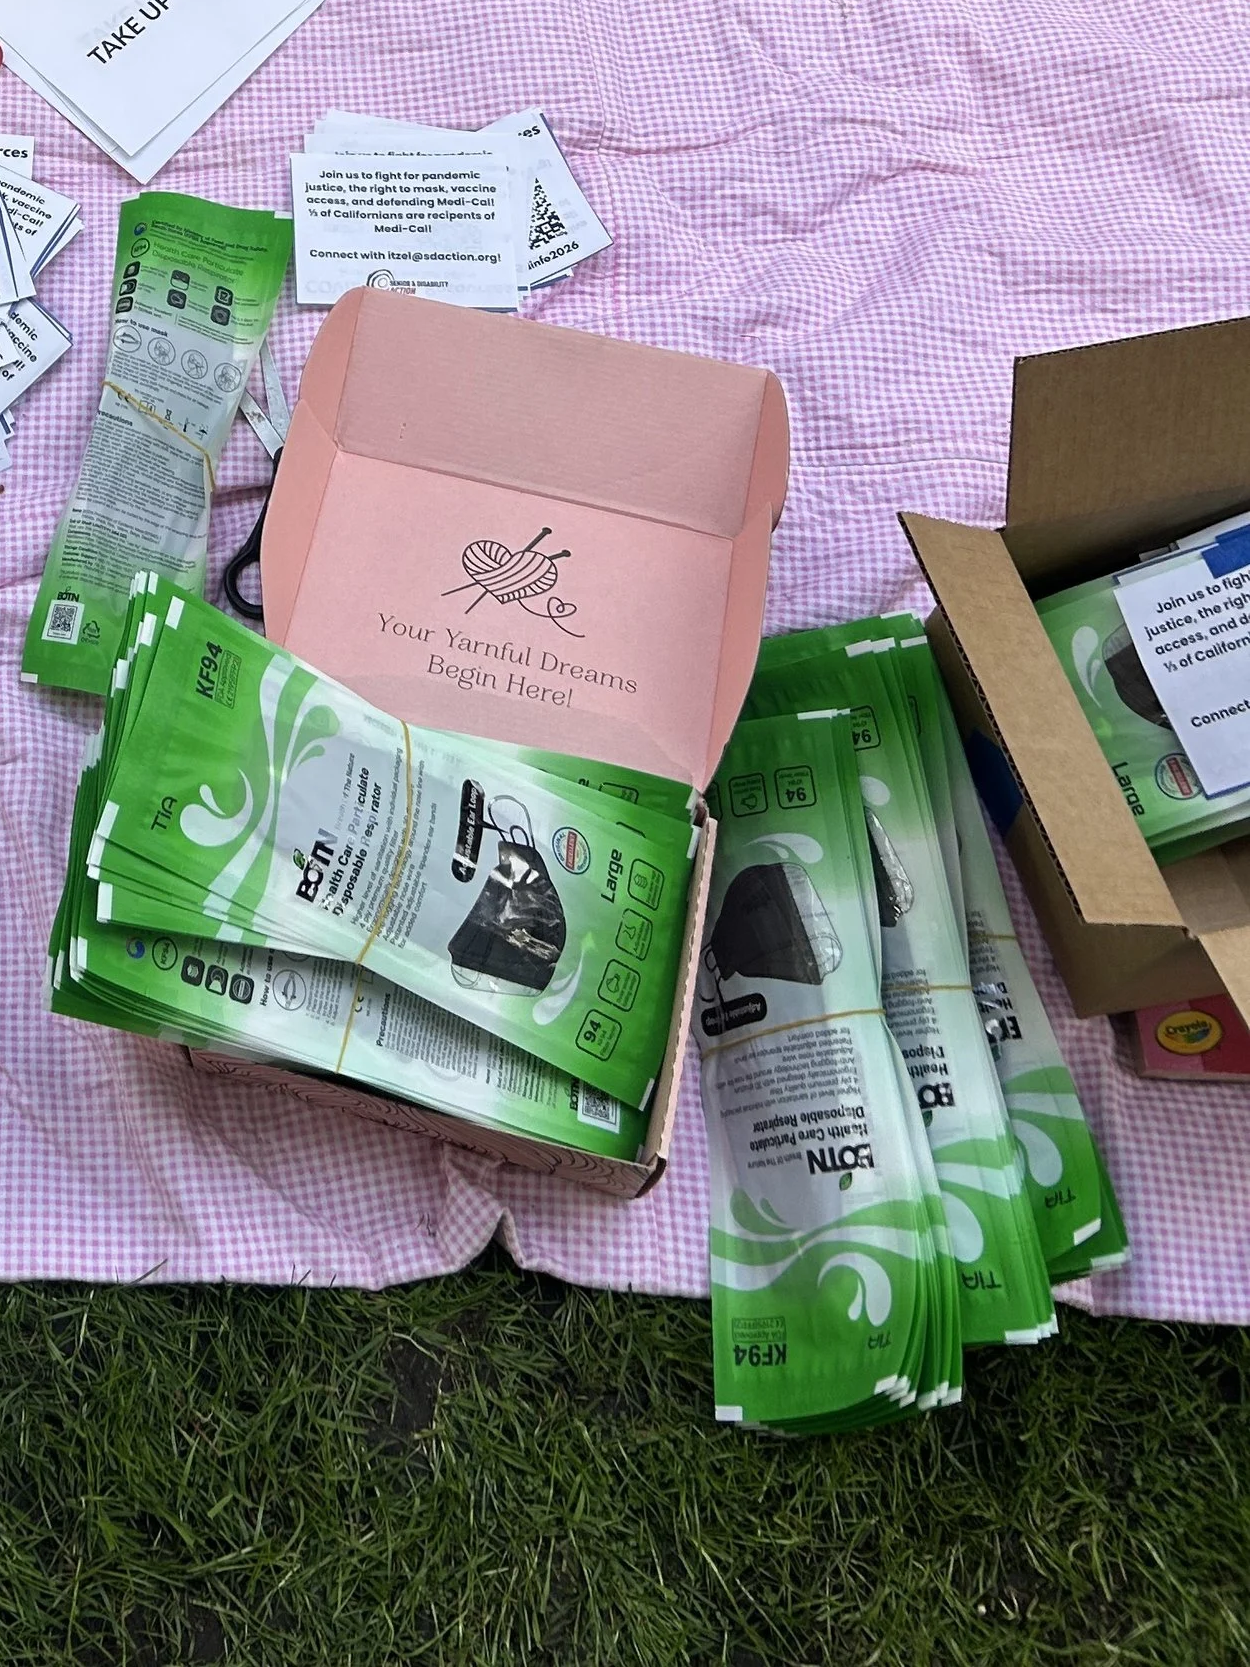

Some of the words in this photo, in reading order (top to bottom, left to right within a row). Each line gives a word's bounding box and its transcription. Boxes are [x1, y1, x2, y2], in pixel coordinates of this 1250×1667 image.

[86, 15, 146, 66] TAKE
[319, 169, 344, 180] Join
[346, 172, 360, 180] us
[361, 171, 374, 180] to
[375, 170, 402, 182] fight
[404, 171, 420, 180] for
[422, 170, 481, 183] pandemic
[305, 183, 346, 194] justice,
[348, 184, 368, 193] the
[370, 184, 397, 195] right
[399, 184, 411, 193] to
[413, 183, 449, 194] mask,
[451, 184, 497, 193] vaccine
[11, 197, 53, 220] vaccine
[306, 197, 349, 207] access,
[351, 197, 374, 206] and
[376, 196, 435, 208] defending
[320, 209, 332, 217] of
[334, 209, 403, 220] Californians
[427, 210, 482, 221] recipents
[484, 210, 496, 220] of
[309, 249, 358, 260] Connect
[360, 250, 386, 260] with
[387, 250, 501, 264] itzel@sdaction.org!
[1155, 596, 1186, 614] Join
[1186, 590, 1205, 602] us
[1206, 584, 1221, 595] to
[1144, 614, 1198, 641] justice,
[1198, 604, 1222, 620] the
[1155, 632, 1209, 656] access,
[1209, 618, 1237, 635] and
[378, 612, 436, 643] Your
[446, 628, 531, 667] Yarnful
[539, 651, 638, 694] Dreams
[195, 641, 223, 700] KF94
[427, 653, 497, 690] Begin
[505, 672, 573, 708] Here!
[785, 787, 807, 803] 94
[601, 848, 622, 904] Large
[376, 992, 391, 1047] Precautions
[583, 1019, 602, 1044] 94
[753, 1114, 797, 1132] Respirator
[800, 1106, 865, 1125] Disposable
[750, 1134, 796, 1151] Particulate
[799, 1128, 825, 1141] Care
[806, 1143, 875, 1175] BOTN
[733, 1343, 787, 1368] KF94
